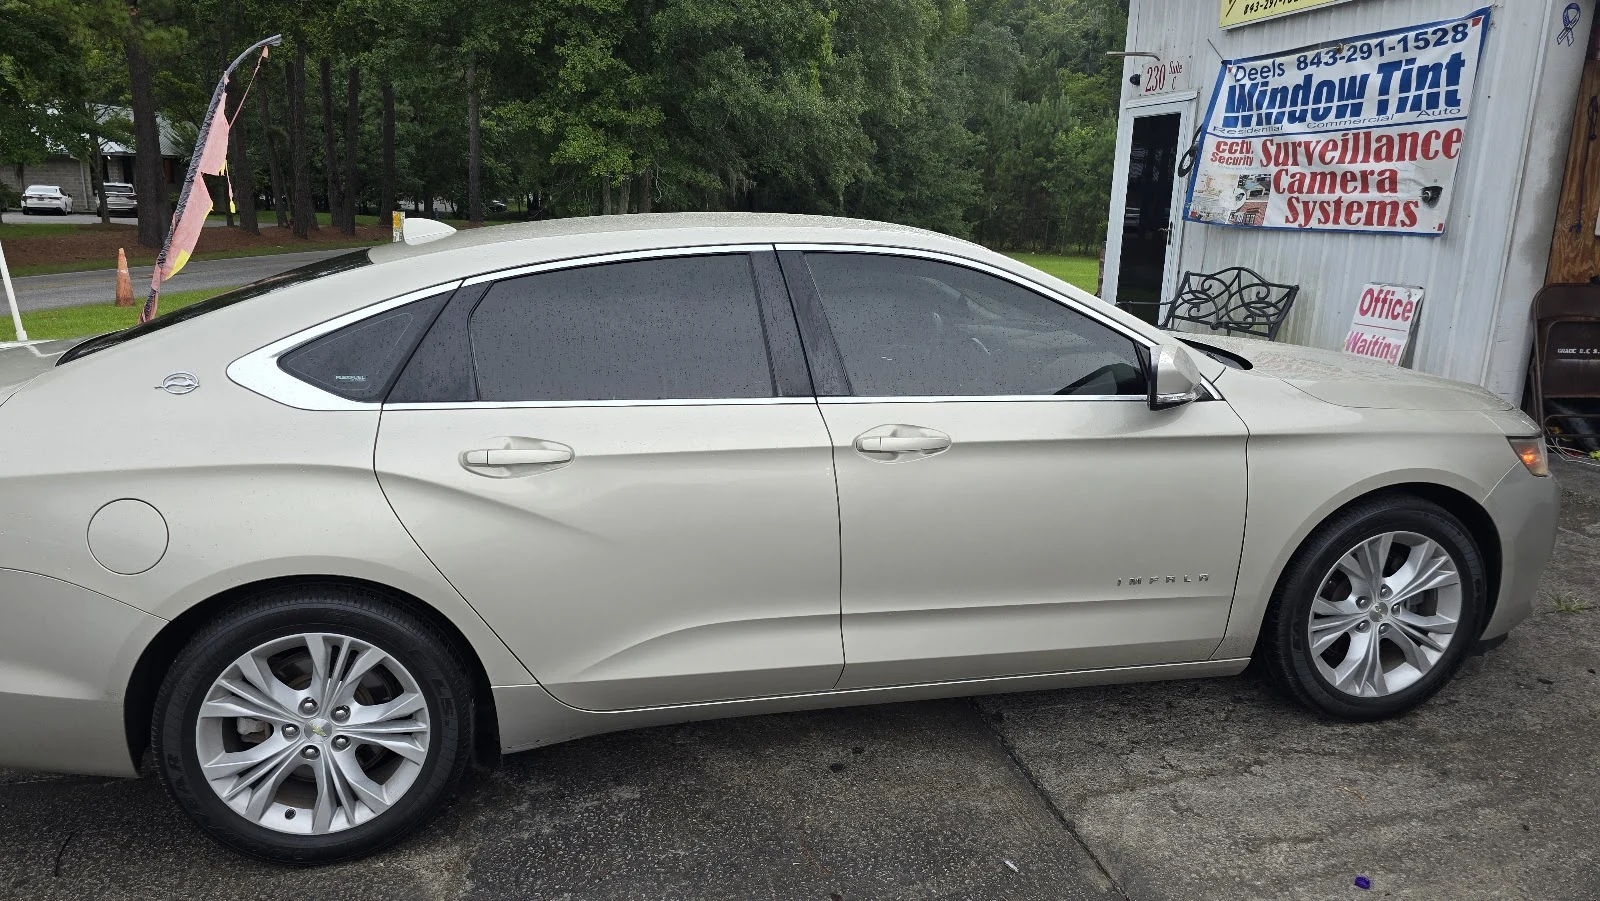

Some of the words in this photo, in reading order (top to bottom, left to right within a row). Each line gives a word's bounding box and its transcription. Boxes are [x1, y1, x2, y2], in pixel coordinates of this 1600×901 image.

[1234, 59, 1285, 82] Deels
[1296, 23, 1469, 71] 843-291-1528
[1145, 64, 1166, 92] 230
[1221, 73, 1371, 128] Window
[1376, 52, 1466, 116] Tint
[1213, 125, 1284, 135] Residential
[1416, 108, 1461, 118] Auto
[1210, 151, 1254, 166] Security
[1259, 127, 1463, 168] Surveillance
[1273, 168, 1399, 195] Camera
[1285, 196, 1419, 229] Systems
[1359, 288, 1414, 322] Office
[1345, 331, 1402, 365] Waiting
[1117, 573, 1209, 587] IMPALA
